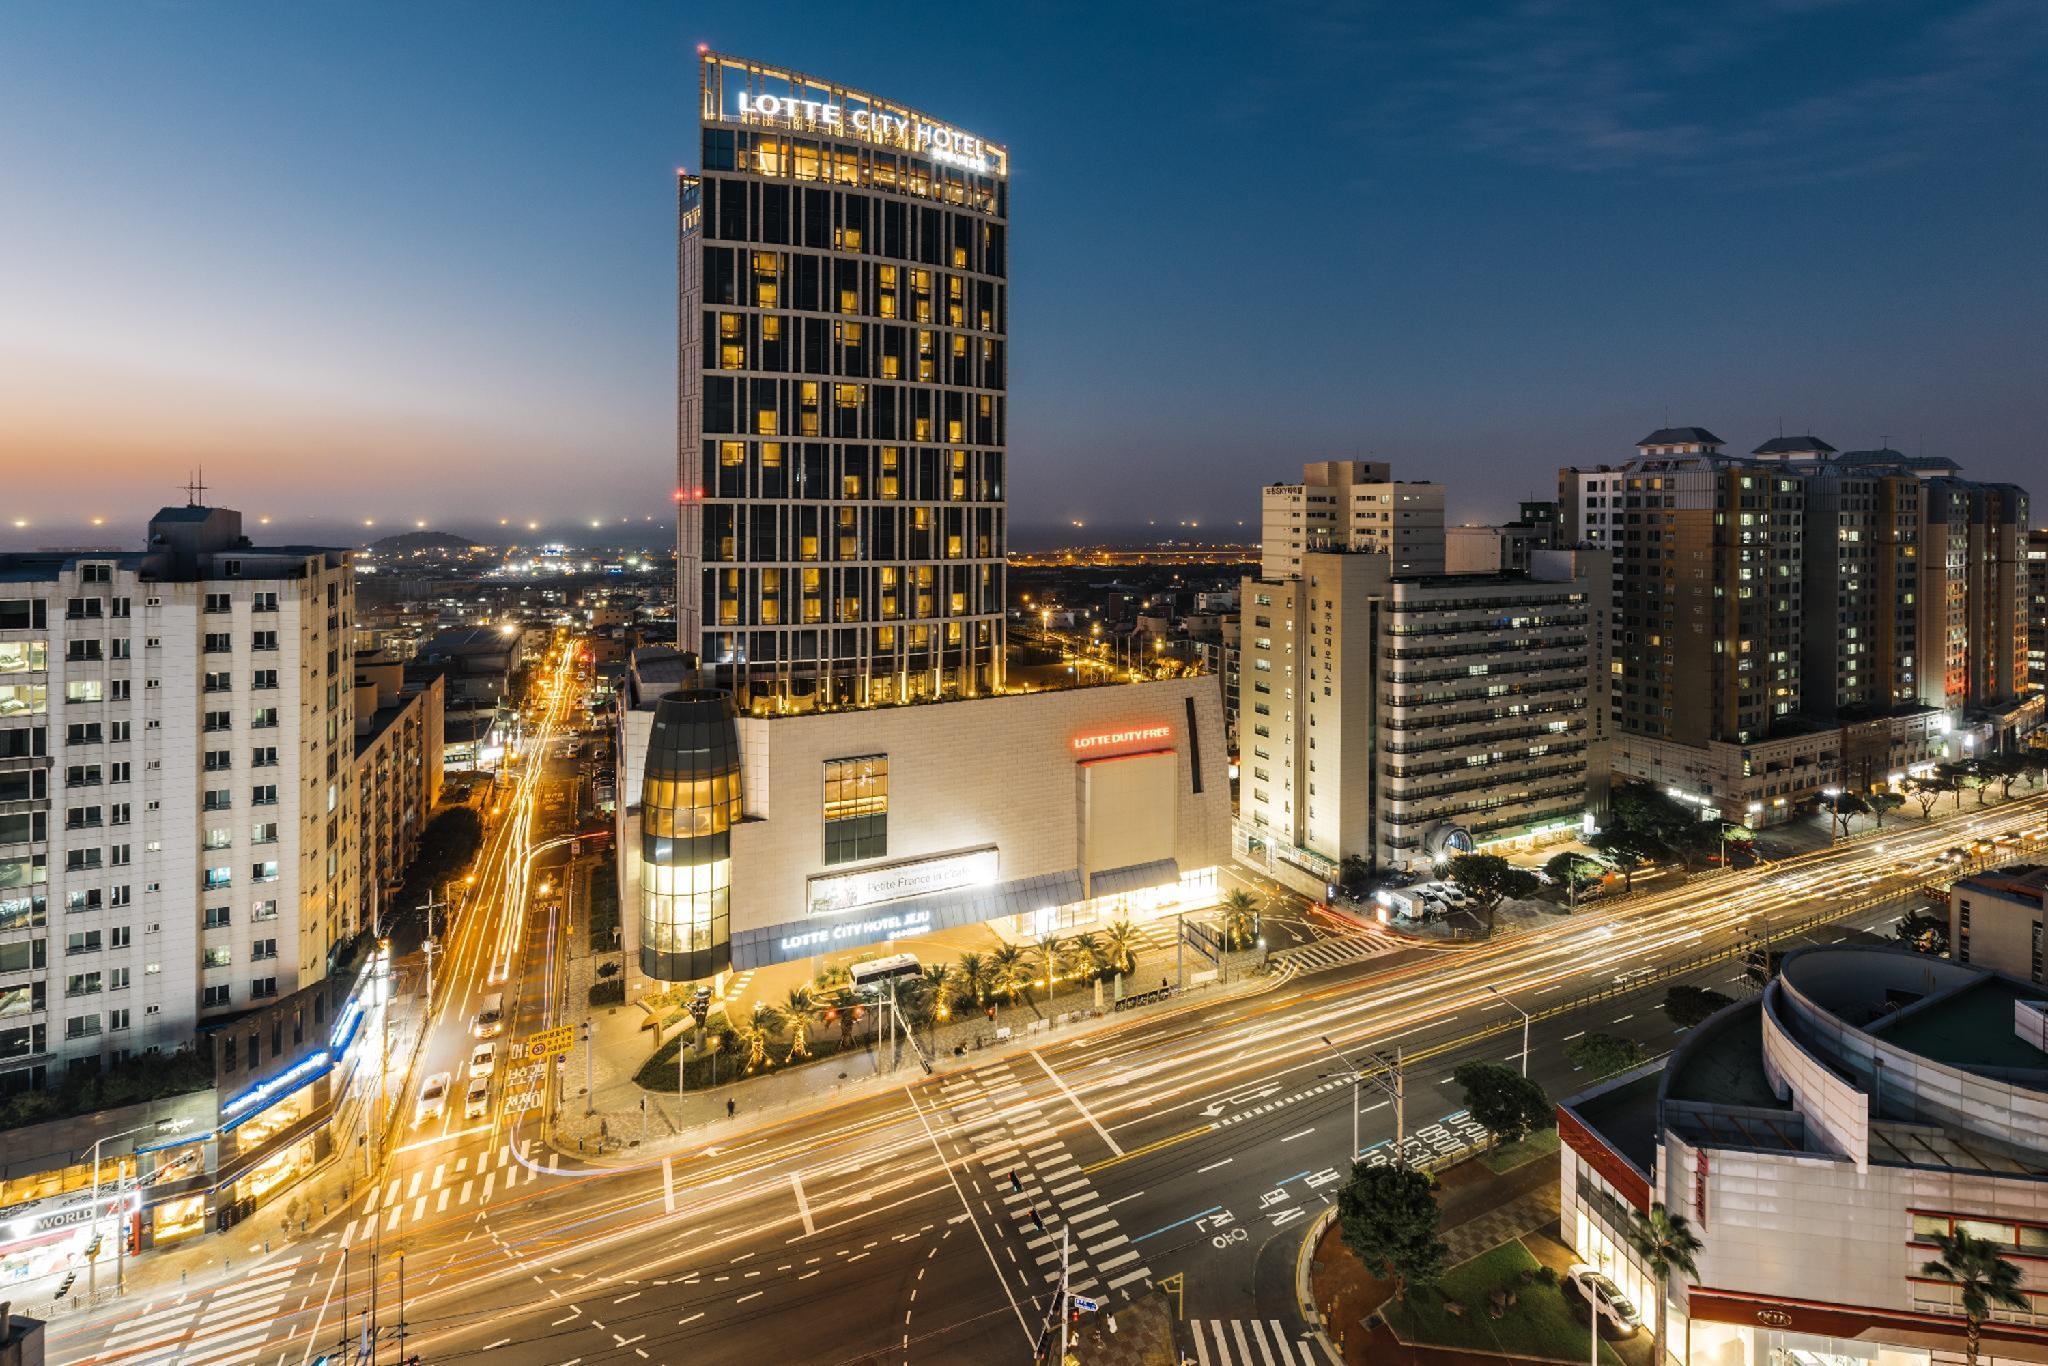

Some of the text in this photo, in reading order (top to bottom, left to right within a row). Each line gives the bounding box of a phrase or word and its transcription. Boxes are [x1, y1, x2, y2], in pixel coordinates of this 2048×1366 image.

[738, 92, 985, 157] LOTTE CITY HOTEL
[1074, 727, 1170, 749] LOTTE DUTY FREE
[897, 874, 931, 888] France
[781, 928, 829, 950] LOTTE
[833, 922, 862, 940] CITY
[863, 916, 902, 934] HOTEL
[904, 910, 931, 925] JEJU
[1416, 1123, 1467, 1157] 09:00
[38, 1208, 95, 1231] WORLD
[1195, 1209, 1248, 1249] 전용
